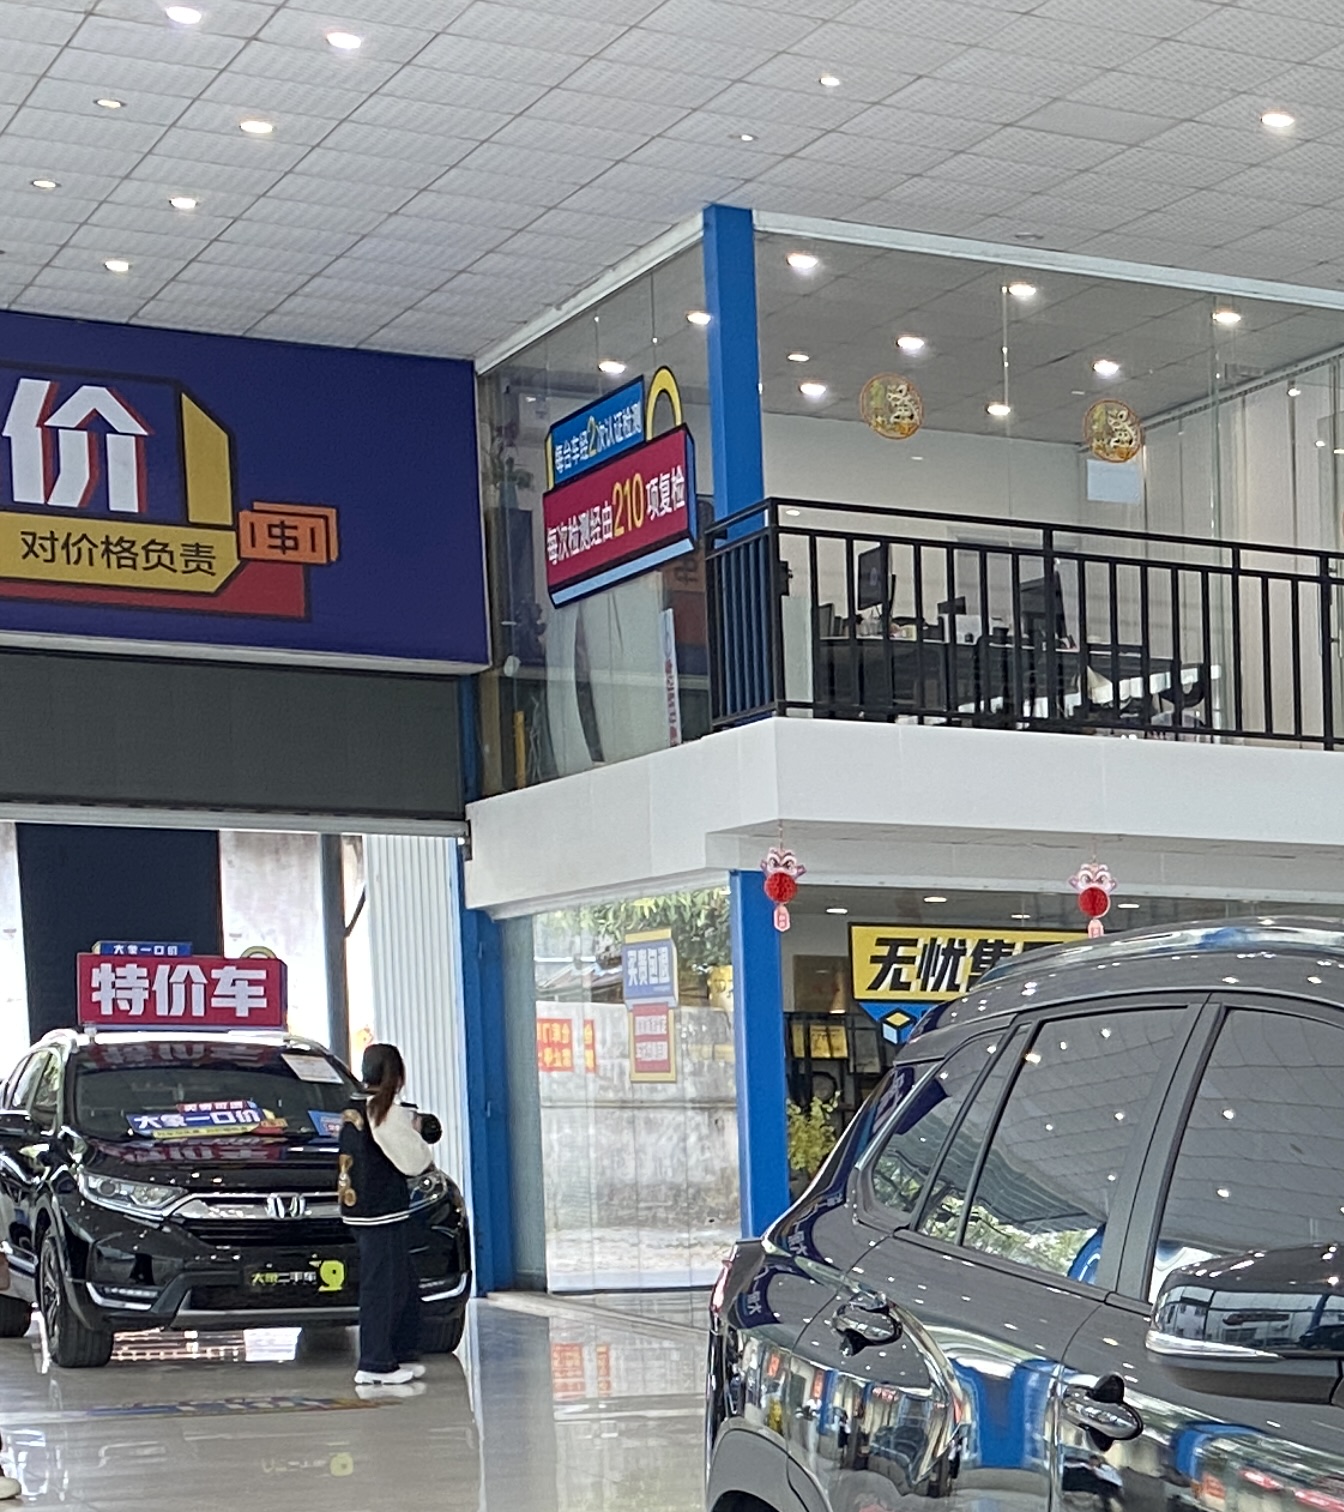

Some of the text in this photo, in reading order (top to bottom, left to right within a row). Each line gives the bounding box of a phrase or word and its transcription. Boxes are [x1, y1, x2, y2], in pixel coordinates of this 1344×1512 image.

[20, 530, 217, 577] 对价格负责
[91, 963, 268, 1018] 特价车
